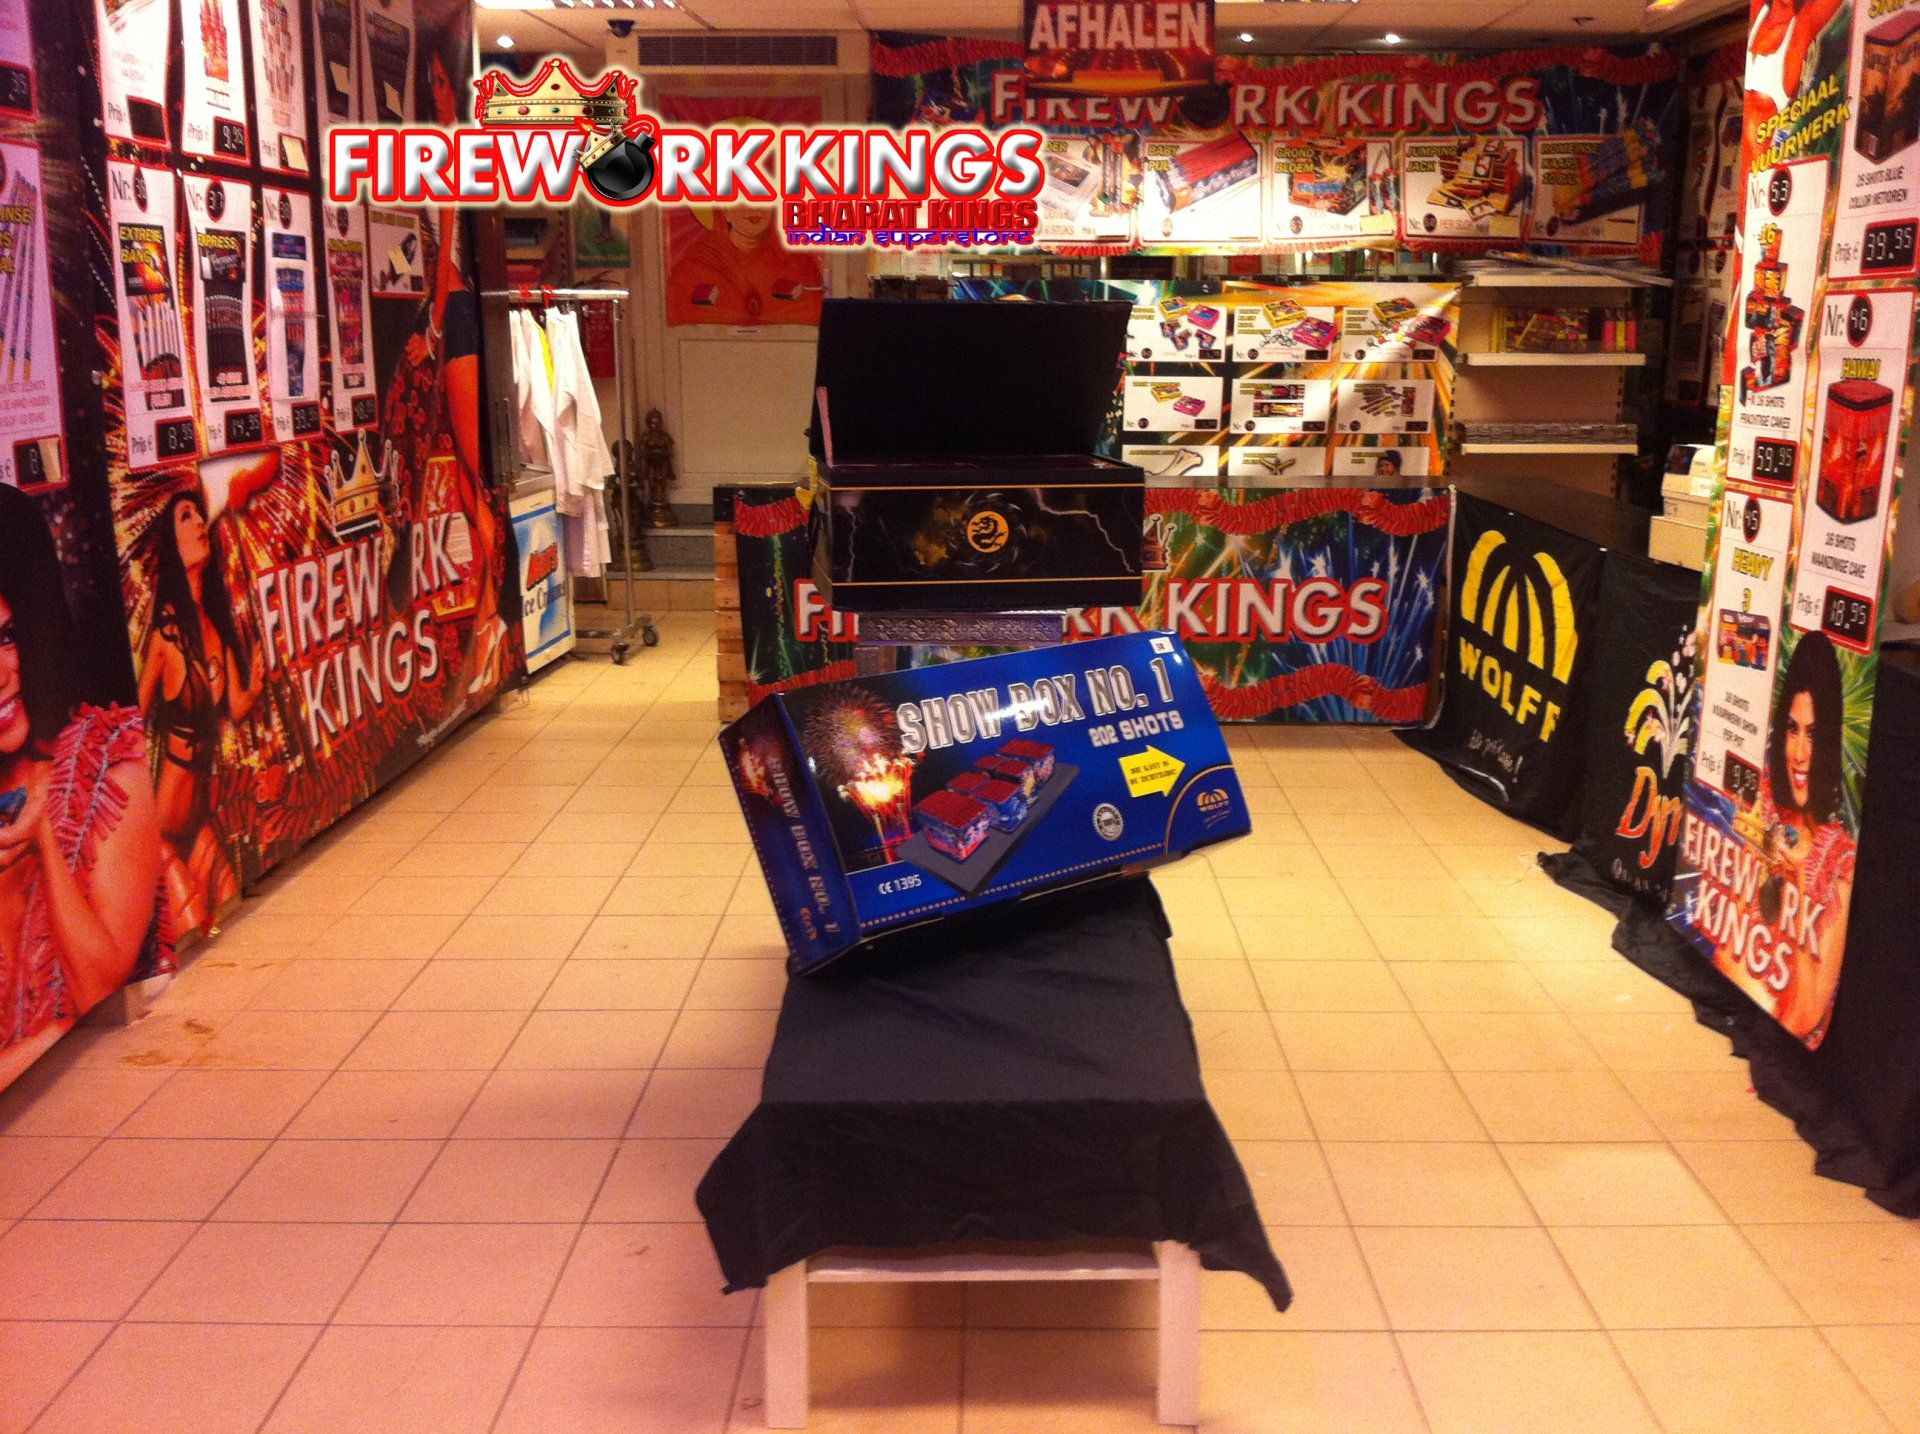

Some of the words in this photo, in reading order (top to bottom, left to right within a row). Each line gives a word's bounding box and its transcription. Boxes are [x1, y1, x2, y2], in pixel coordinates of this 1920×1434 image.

[1029, 3, 1208, 50] AFHALEN
[1337, 80, 1536, 126] KINGS
[1755, 74, 1841, 145] SPECIAAL
[1275, 148, 1314, 158] GROND
[1275, 162, 1314, 173] BLOEM
[1750, 101, 1851, 177] VUURWERK
[1168, 580, 1385, 637] KINGS
[303, 608, 439, 749] KINGS
[896, 688, 1003, 754] SHOW
[1007, 674, 1085, 732] BOX
[1085, 665, 1149, 716] NO.
[1149, 658, 1174, 703] 1
[1459, 637, 1561, 743] WOLFF
[1088, 726, 1120, 748] 202
[1121, 710, 1185, 740] SHOTS
[768, 756, 801, 818] SHOW
[789, 824, 819, 870] BOX
[892, 874, 923, 893] 1395
[1696, 879, 1793, 992] KINGS
